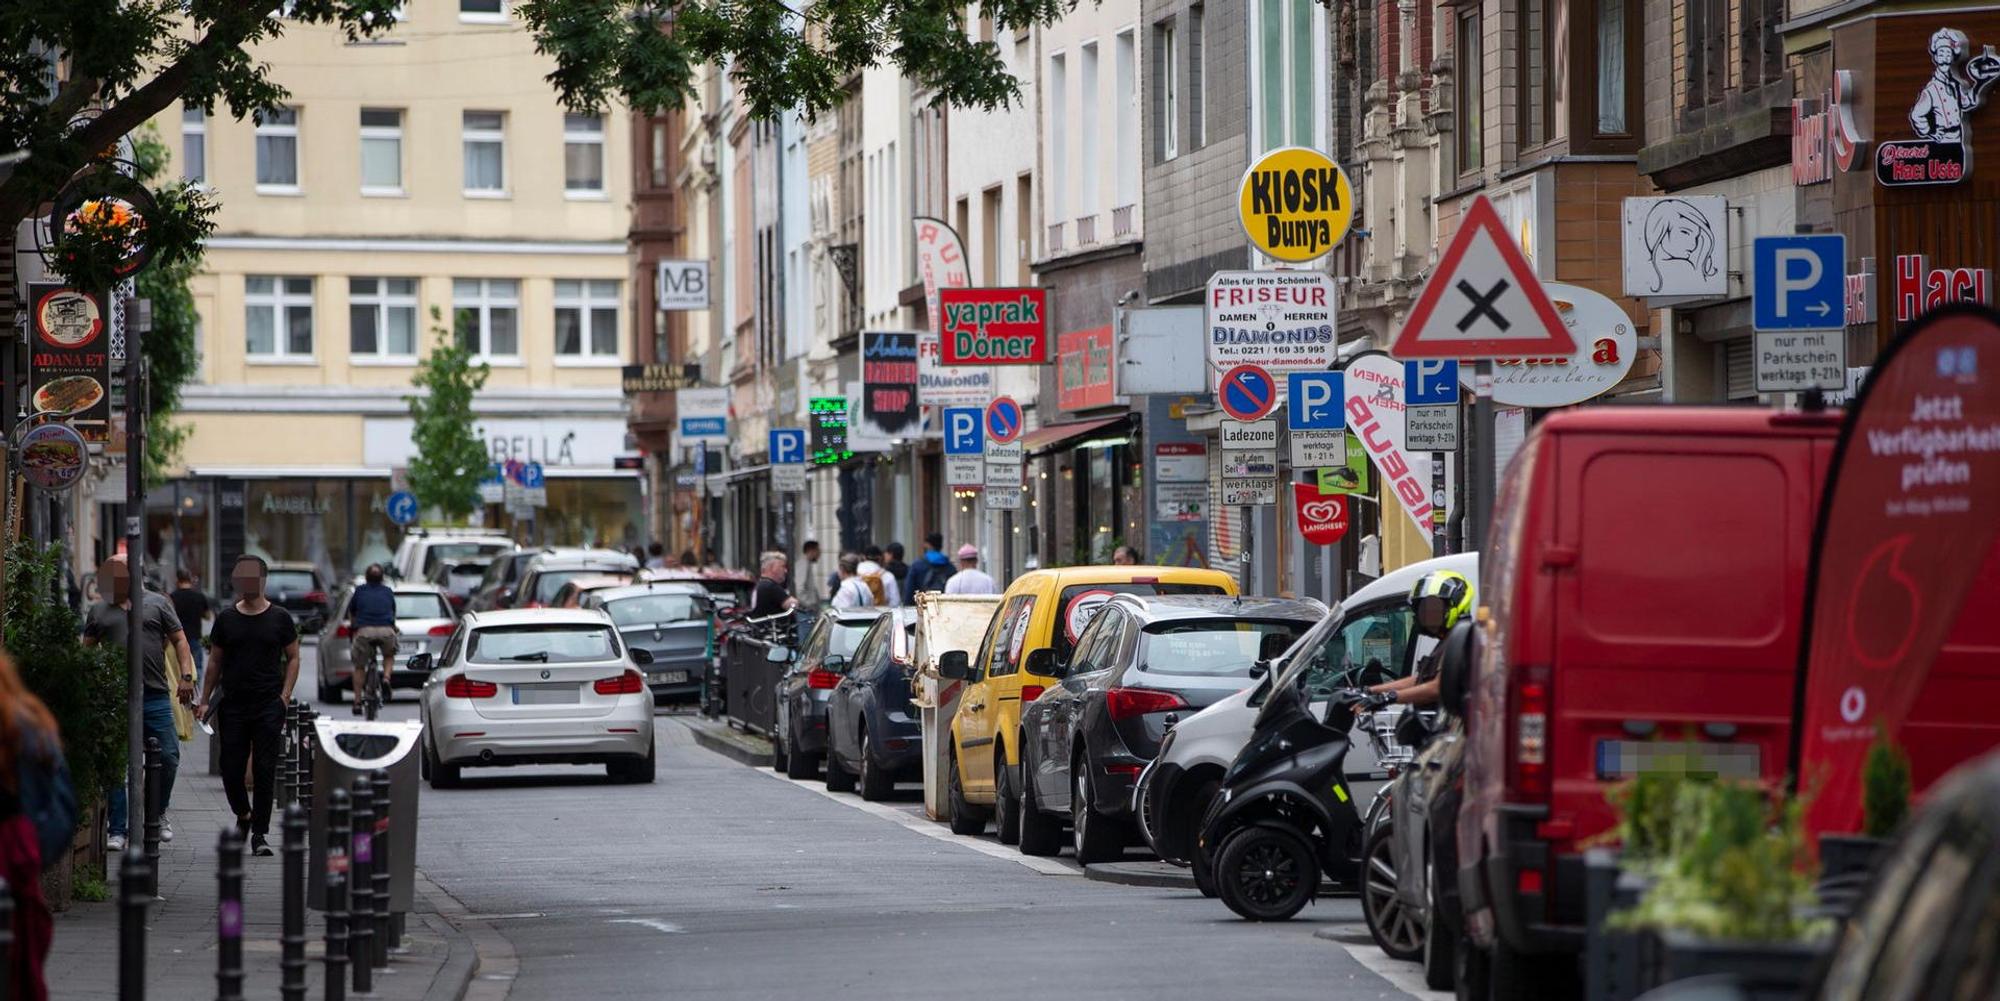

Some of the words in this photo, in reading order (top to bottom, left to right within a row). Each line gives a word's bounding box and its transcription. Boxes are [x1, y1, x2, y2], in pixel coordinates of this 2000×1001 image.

[1928, 157, 1963, 181] Usta
[1251, 167, 1341, 215] KIOSK
[1267, 214, 1331, 253] Dunya
[664, 267, 704, 294] MB
[1218, 278, 1239, 286] Alles
[1242, 277, 1256, 286] für
[1257, 277, 1275, 285] Ihre
[1277, 276, 1321, 285] Schönheit
[1775, 248, 1823, 318] P
[1213, 286, 1327, 309] FRISEUR
[945, 294, 1040, 331] yaprak
[1219, 313, 1257, 322] DAMEN
[1284, 312, 1328, 321] HERREN
[1213, 325, 1332, 345] DIAMONDS
[1774, 338, 1797, 347] nur
[1803, 335, 1826, 346] mit
[954, 329, 1036, 359] Döner
[1218, 347, 1239, 355] Tel.:
[1241, 347, 1264, 355] 0221
[1274, 346, 1290, 354] 169
[1293, 346, 1306, 354] 35
[1307, 345, 1326, 353] 995
[33, 353, 82, 367] ADANA
[86, 353, 105, 366] ET
[1763, 351, 1837, 365] Parkschein
[919, 372, 990, 388] DIAMONDS
[1417, 360, 1446, 396] P
[1761, 368, 1807, 383] werktags
[872, 390, 911, 413] SHOP
[1302, 380, 1332, 423] P
[1910, 396, 1963, 422] Jetzt
[1416, 410, 1430, 418] nur
[1433, 409, 1447, 417] mit
[953, 413, 975, 449] P
[1410, 421, 1453, 431] Parkschein
[1223, 428, 1275, 442] Ladezone
[1409, 434, 1435, 446] werktags
[777, 432, 797, 463] P
[987, 447, 1020, 458] Ladezone
[1302, 442, 1334, 452] werktags
[1234, 453, 1246, 463] auf
[1303, 453, 1312, 461] 18
[1318, 452, 1327, 461] 21
[1901, 457, 1971, 491] prüfen
[1226, 480, 1274, 491] werktags
[1303, 521, 1343, 532] LANGNESE
